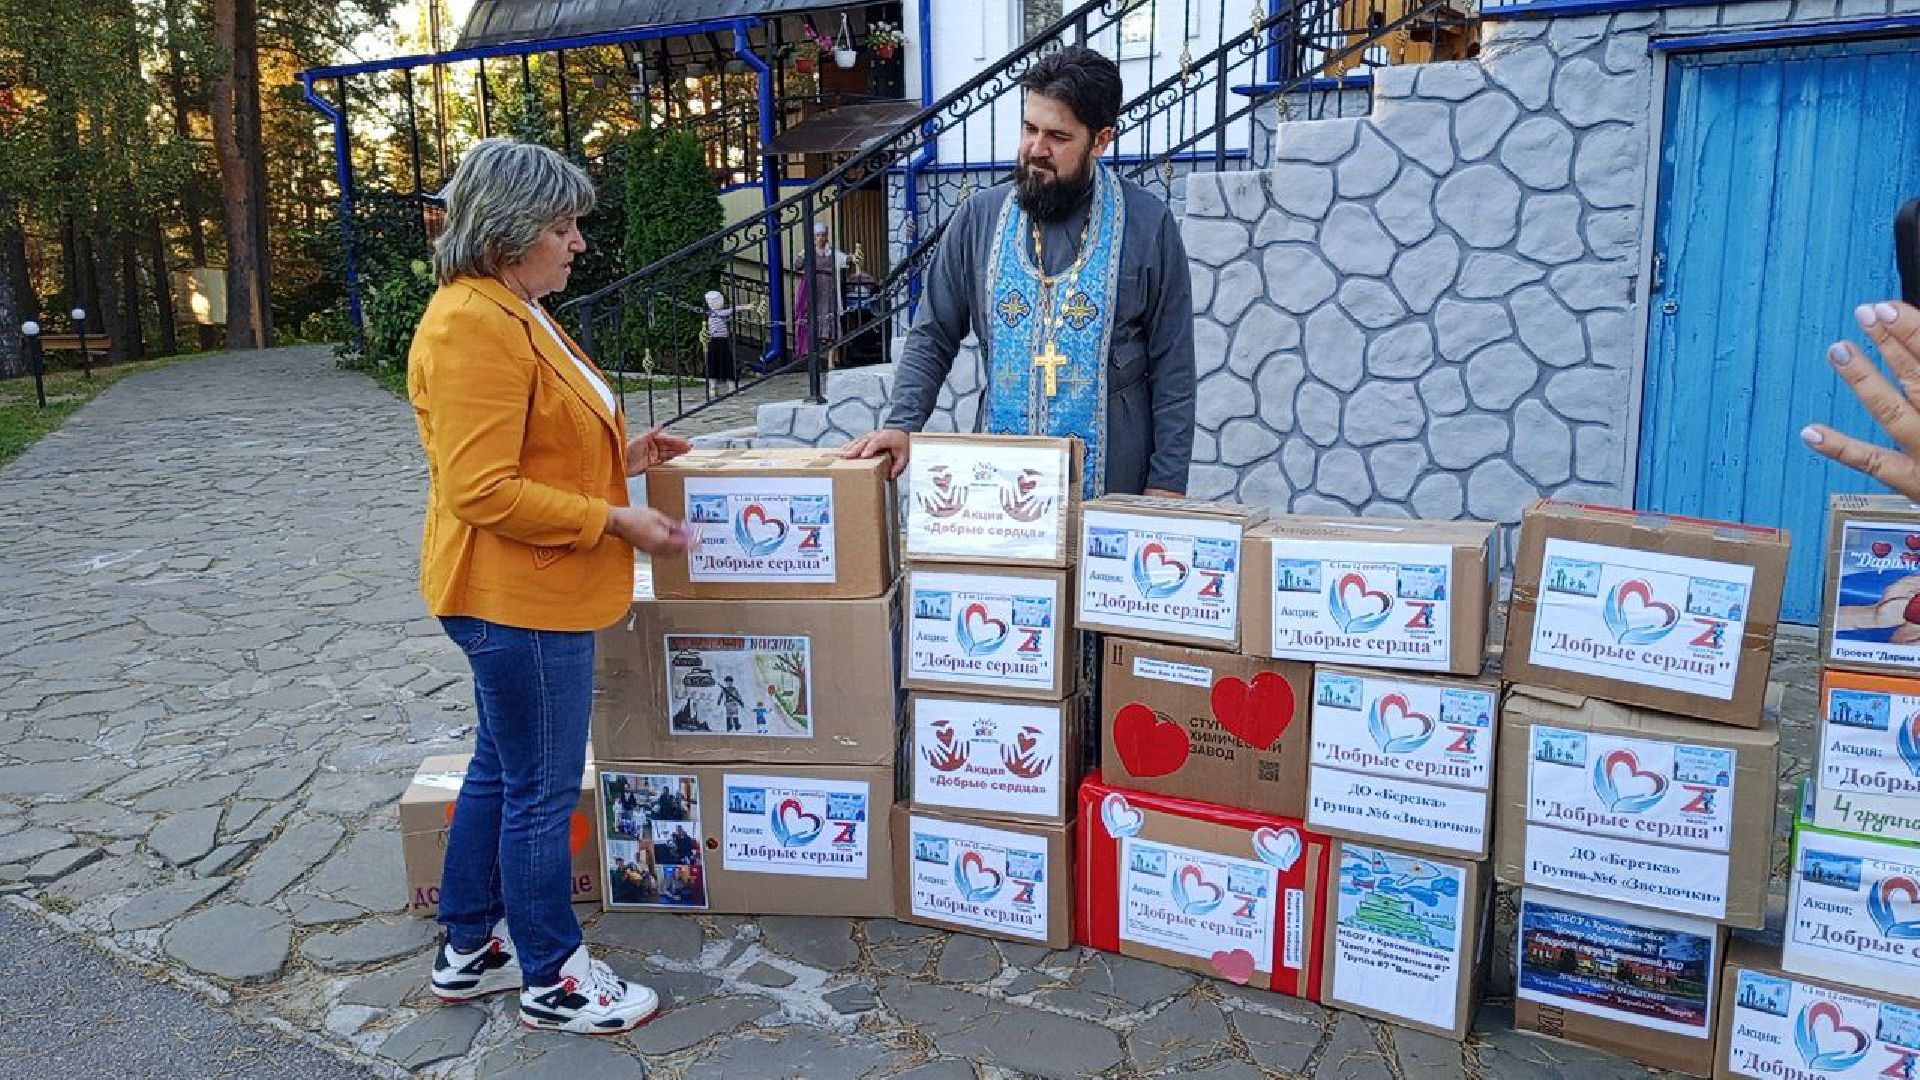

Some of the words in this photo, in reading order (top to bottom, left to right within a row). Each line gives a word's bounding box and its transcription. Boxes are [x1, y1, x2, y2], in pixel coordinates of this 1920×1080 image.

[962, 509, 1003, 521] Акция
[924, 522, 984, 535] «Добрые
[988, 528, 1045, 538] сердца»
[695, 555, 763, 571] "Добрые
[768, 555, 829, 571] сердца"
[1089, 570, 1123, 582] Акция:
[1087, 591, 1159, 613] "Добрые
[1164, 602, 1231, 620] сердца"
[1281, 606, 1318, 619] Акция:
[916, 631, 948, 642] Акция:
[1279, 628, 1361, 650] "Добрые
[1366, 639, 1443, 655] сердца"
[1542, 630, 1635, 661] "Добрые
[1641, 650, 1730, 676] сердца"
[1837, 648, 1873, 660] Проект
[915, 651, 982, 670] "Добрые
[986, 660, 1048, 675] сердца"
[1190, 743, 1235, 761] ЗАВОД
[1831, 741, 1882, 757] Акция:
[1316, 742, 1399, 768] "Добрые
[1405, 757, 1483, 778] сердца"
[965, 763, 1005, 775] Акция
[930, 775, 987, 789] «Добрые
[991, 782, 1046, 794] сердца»
[1348, 784, 1371, 796] ДО
[1314, 798, 1363, 815] Группа
[1834, 794, 1851, 822] 4
[1536, 799, 1629, 829] "Добрые
[1635, 818, 1724, 840] сердца"
[730, 825, 763, 835] Акция:
[729, 843, 797, 860] "Добрые
[801, 851, 863, 864] сердца"
[1569, 847, 1596, 862] ДО
[918, 873, 947, 885] Акция:
[1132, 883, 1162, 896] Акция:
[917, 891, 979, 913] "Добрые
[983, 906, 1042, 924] сердца"
[1803, 897, 1853, 916] Акция:
[1131, 901, 1197, 926] "Добрые
[1200, 920, 1263, 939] сердца"
[1801, 921, 1904, 955] "Добрые
[1343, 952, 1375, 968] Группа
[1737, 1024, 1781, 1044] Акция:
